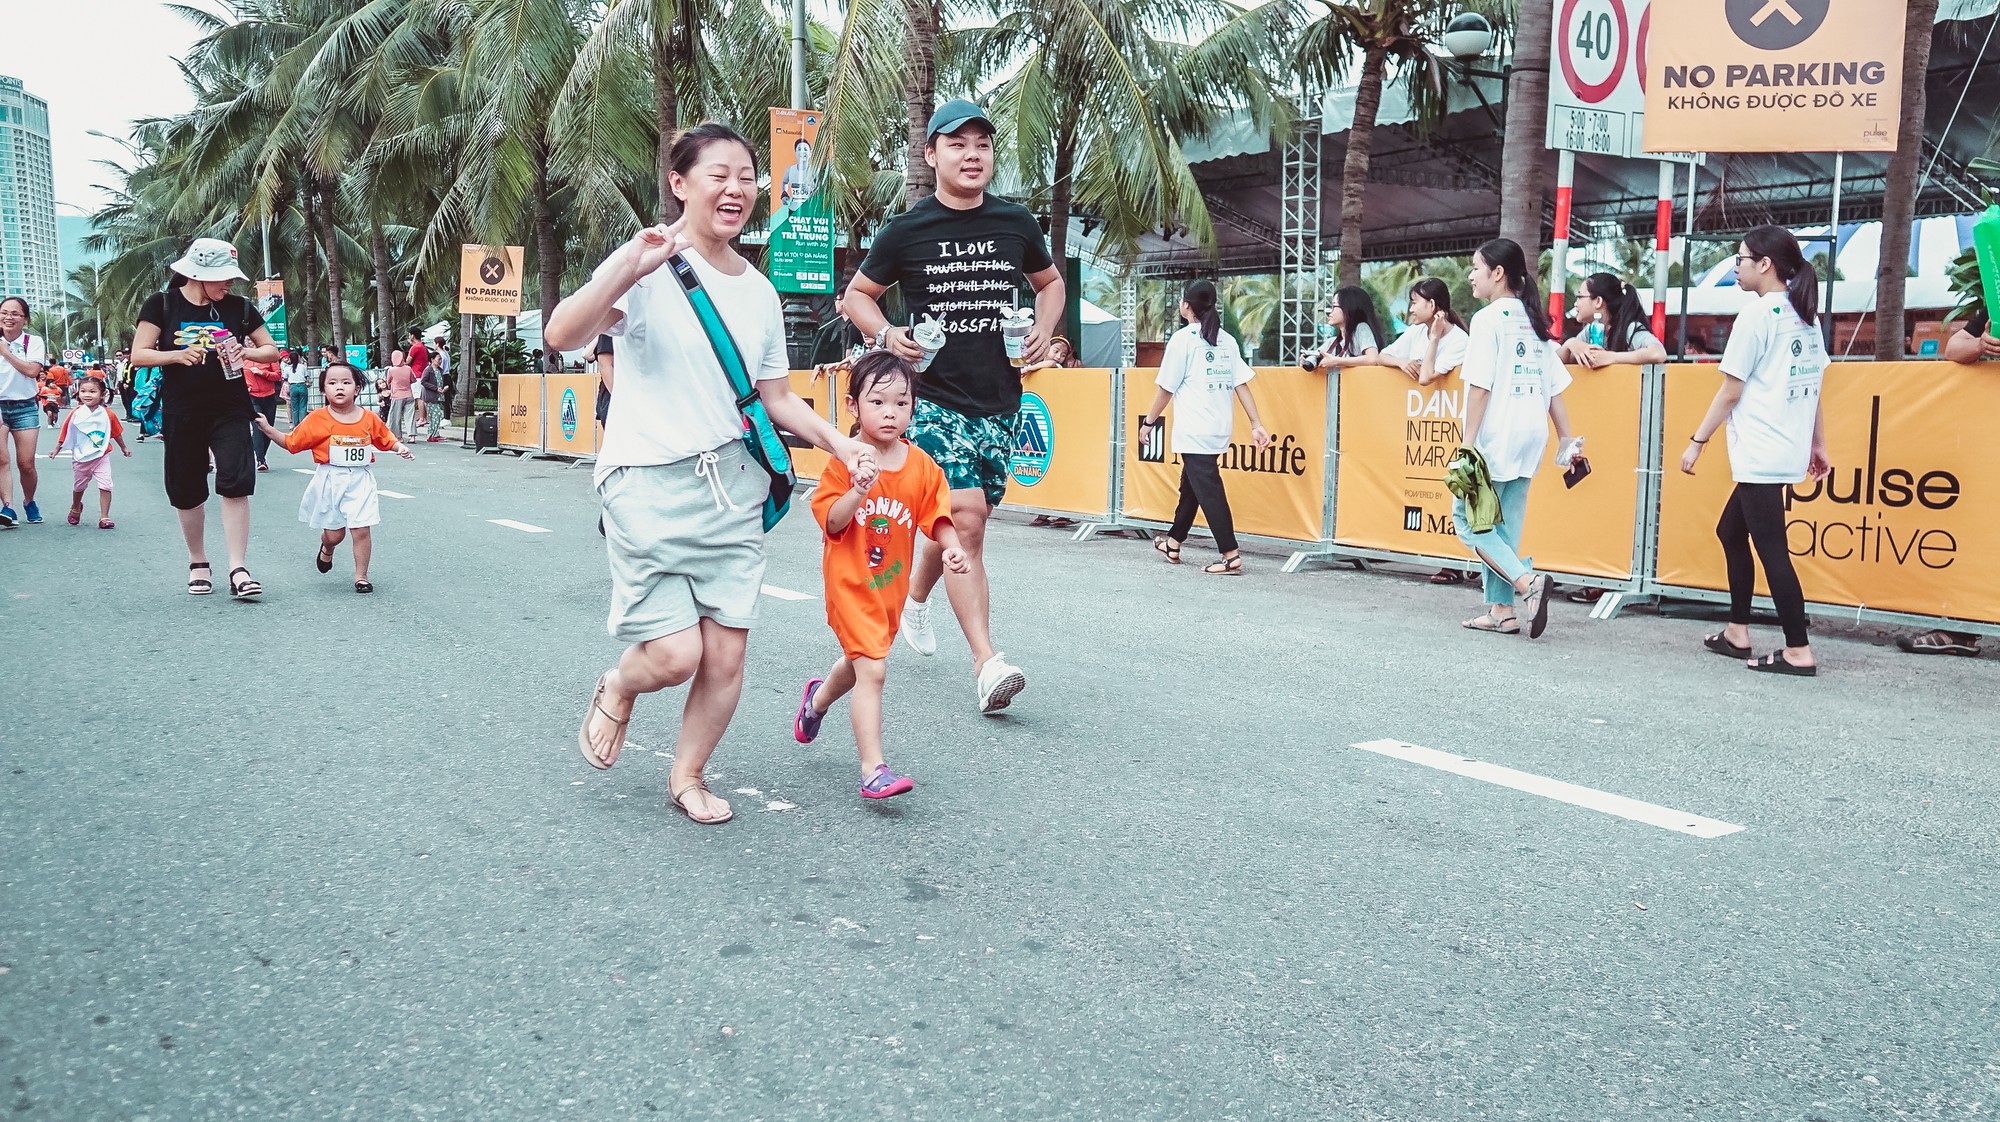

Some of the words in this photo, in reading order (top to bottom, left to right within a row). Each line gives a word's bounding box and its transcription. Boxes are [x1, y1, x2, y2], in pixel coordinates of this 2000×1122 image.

[1576, 10, 1612, 60] 40
[1663, 65, 1716, 88] NO
[1725, 61, 1886, 88] PARKING
[1668, 92, 1740, 110] KHÔNG
[1746, 92, 1807, 111] ĐƯỢC
[1850, 92, 1878, 107] XE
[798, 233, 829, 241] TRUNG
[938, 241, 952, 257] I
[955, 240, 997, 256] LOVE
[924, 260, 1014, 275] POWERLIFTING
[479, 288, 518, 297] PARKING
[928, 279, 1012, 293] BODYBUILDING
[929, 300, 1011, 312] WEIGHTLIFTING
[511, 383, 527, 419] pulse
[1406, 389, 1464, 419] DAN
[344, 448, 365, 461] 189
[1404, 489, 1434, 500] POWERED
[1435, 491, 1443, 500] BY
[1785, 512, 1957, 569] active
